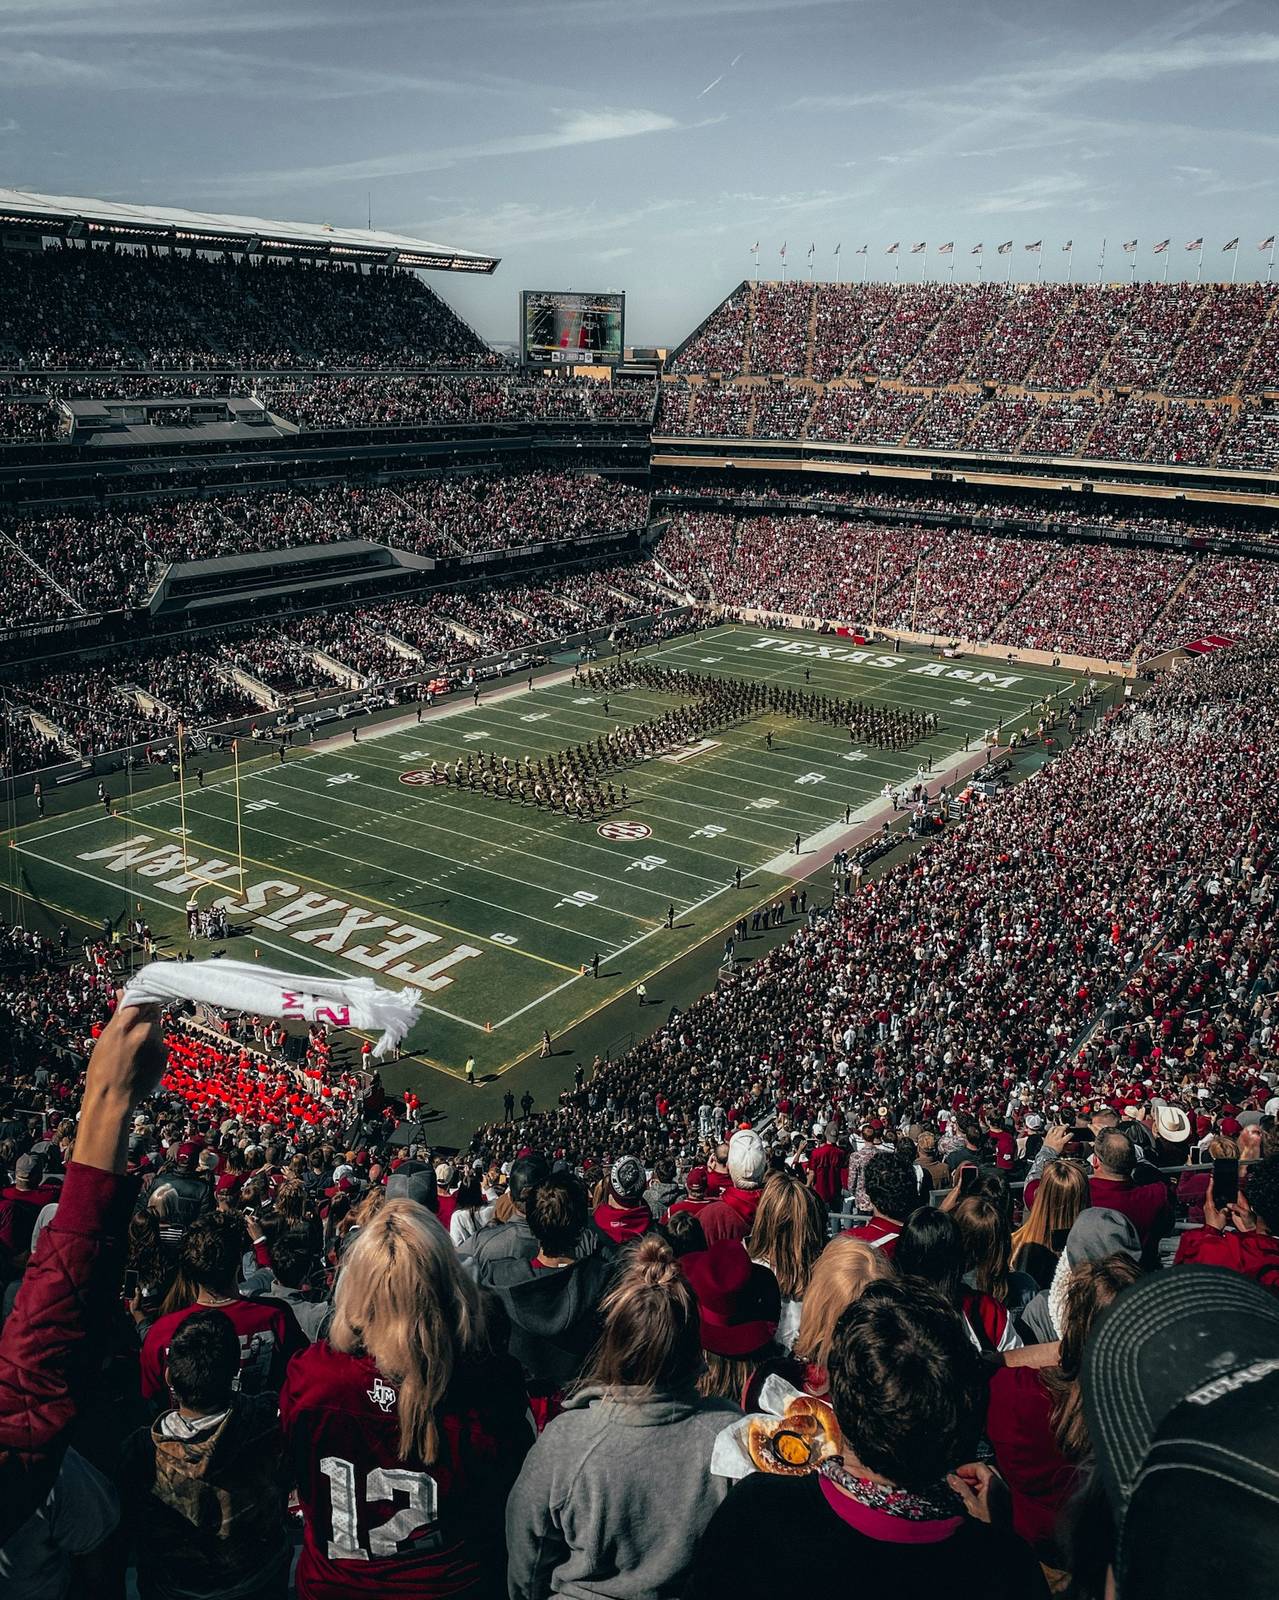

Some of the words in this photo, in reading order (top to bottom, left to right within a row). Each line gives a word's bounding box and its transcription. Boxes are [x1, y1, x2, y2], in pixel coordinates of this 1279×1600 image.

[33, 623, 54, 636] SPIRIT
[55, 622, 63, 632] OF
[750, 637, 906, 668] TEXAS
[908, 662, 1024, 689] A&M
[326, 772, 361, 785] 20
[694, 823, 728, 839] 30
[75, 834, 249, 895] A&M
[632, 854, 668, 872] 20
[560, 890, 599, 908] 10
[212, 879, 484, 992] TEXAS
[489, 932, 519, 946] G
[319, 1456, 439, 1561] 12
